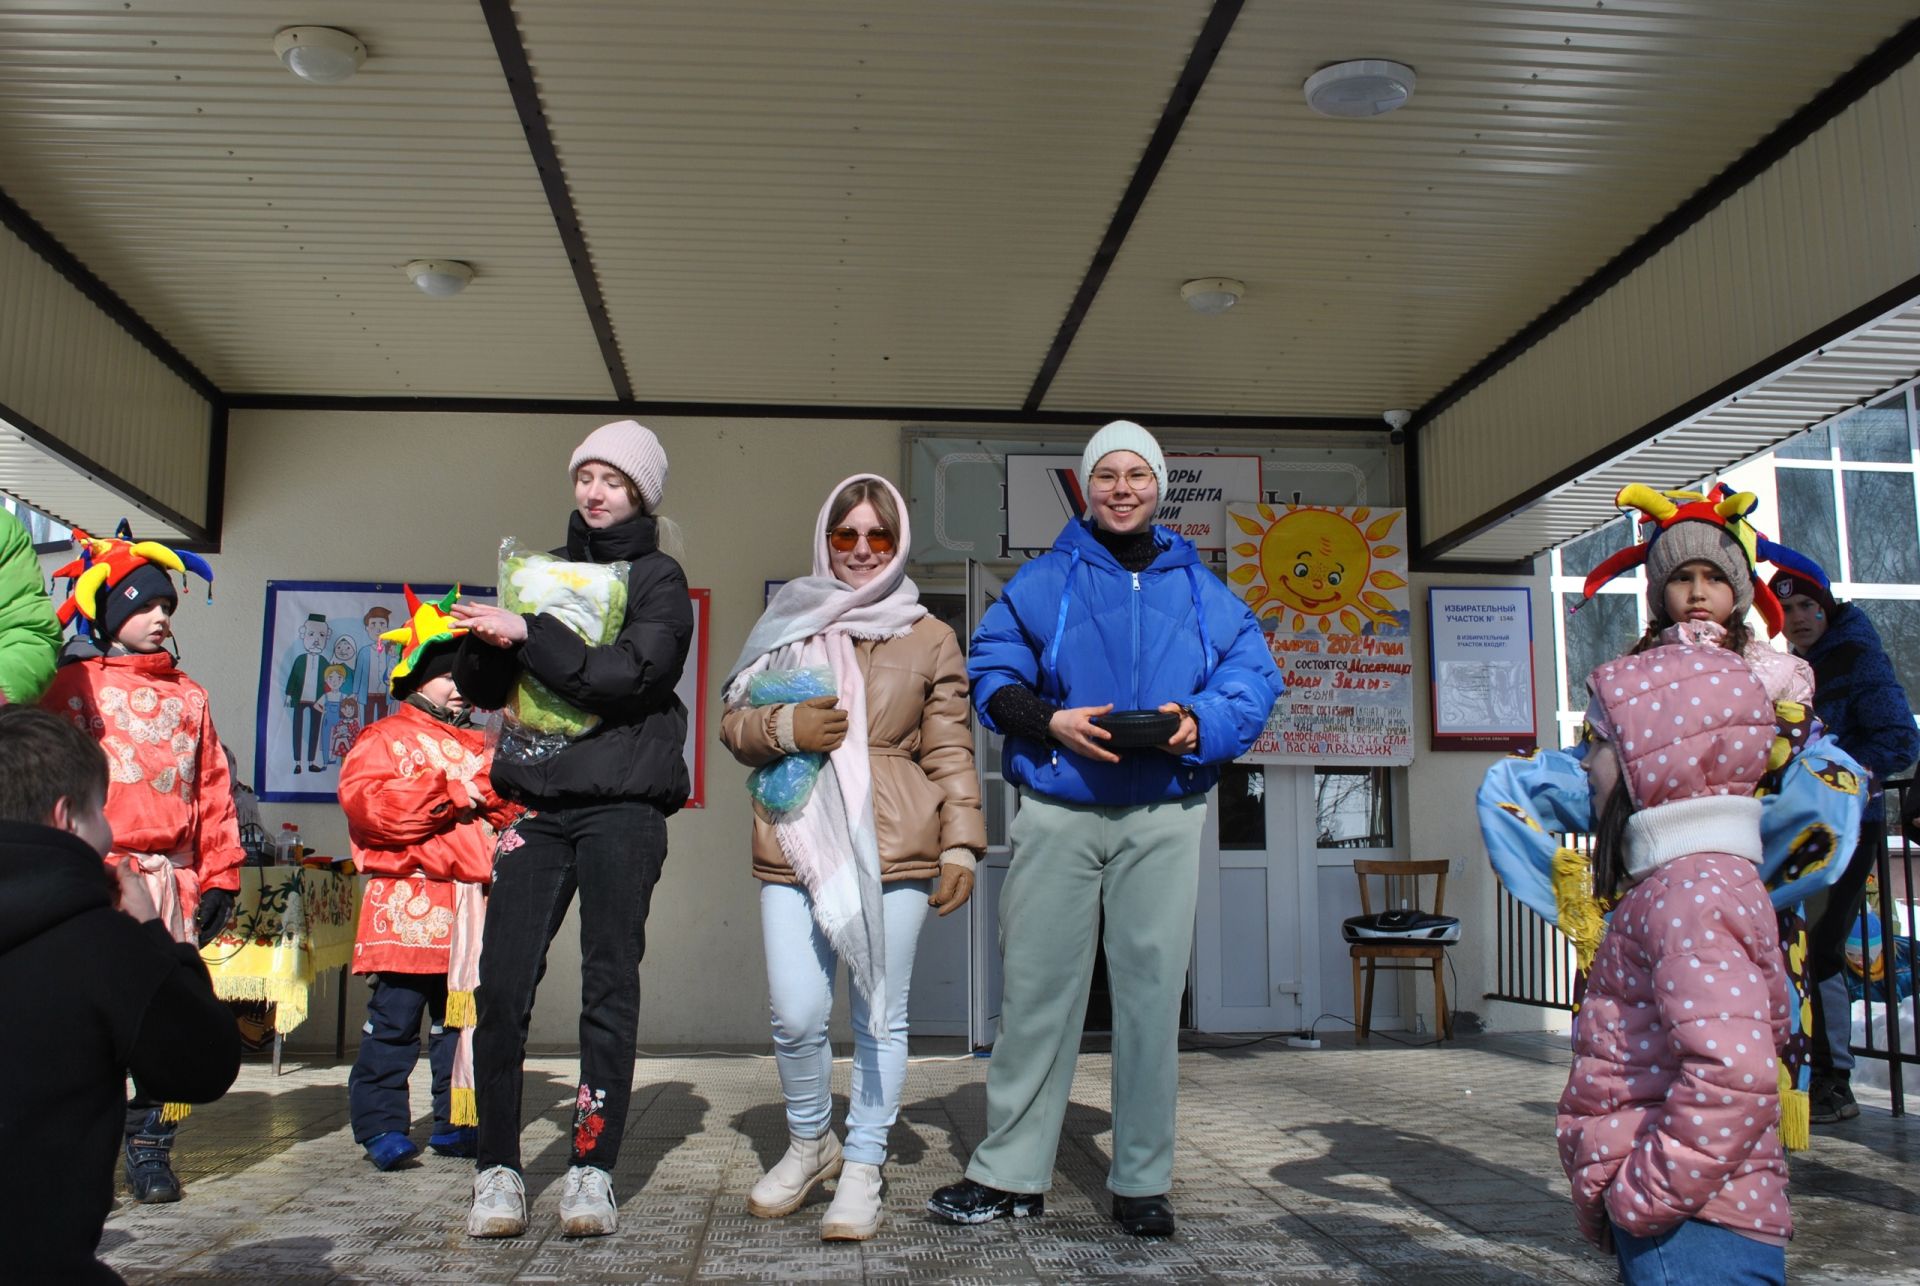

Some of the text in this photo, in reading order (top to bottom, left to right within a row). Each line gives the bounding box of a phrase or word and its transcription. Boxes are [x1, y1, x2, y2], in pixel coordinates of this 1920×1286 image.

[1167, 469, 1203, 484] ОРЫ
[1164, 487, 1223, 503] ИДЕНТА
[1184, 523, 1213, 536] 2024
[1445, 604, 1516, 613] ИЗБИРАТЕЛЬНЫЙ
[1446, 615, 1484, 623] УЧАСТОК
[1327, 633, 1376, 657] 2024
